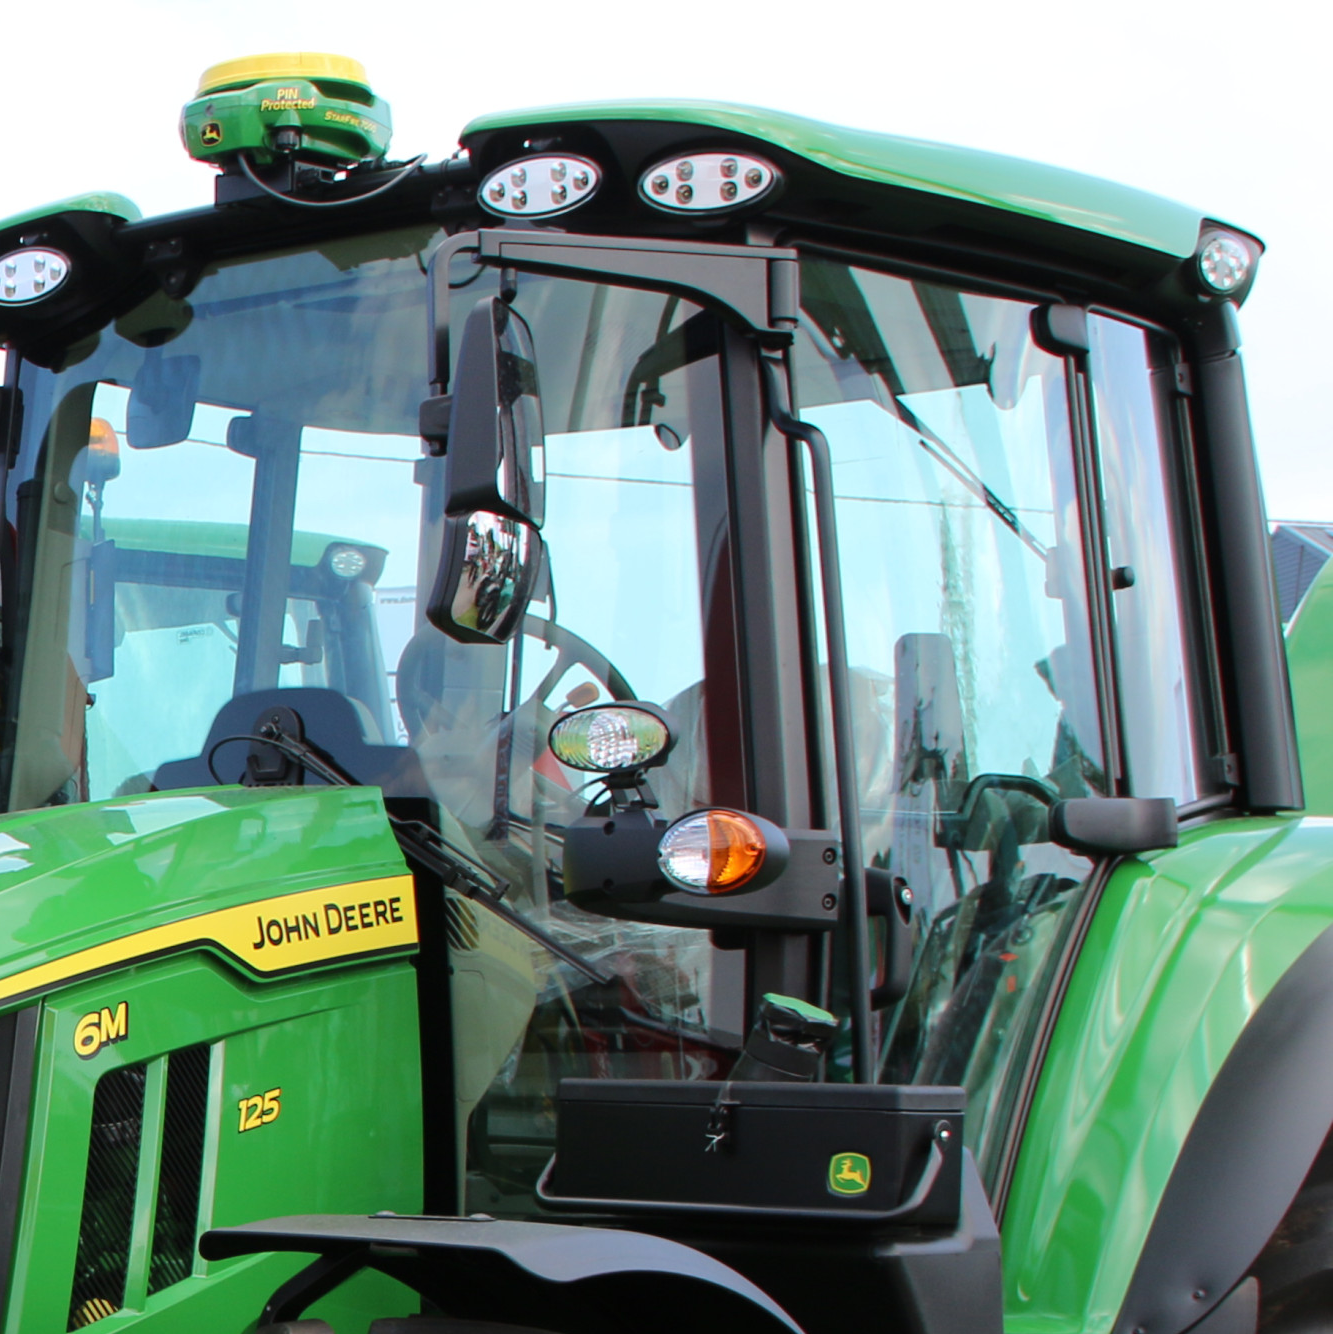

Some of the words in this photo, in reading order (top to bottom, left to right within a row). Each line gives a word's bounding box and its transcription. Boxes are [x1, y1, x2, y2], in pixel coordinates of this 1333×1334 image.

[261, 97, 316, 112] Protected
[276, 88, 299, 100] PIN
[253, 914, 320, 950] JOHN
[324, 897, 404, 935] DEERE
[74, 1001, 128, 1060] 6M
[238, 1086, 282, 1133] 125
